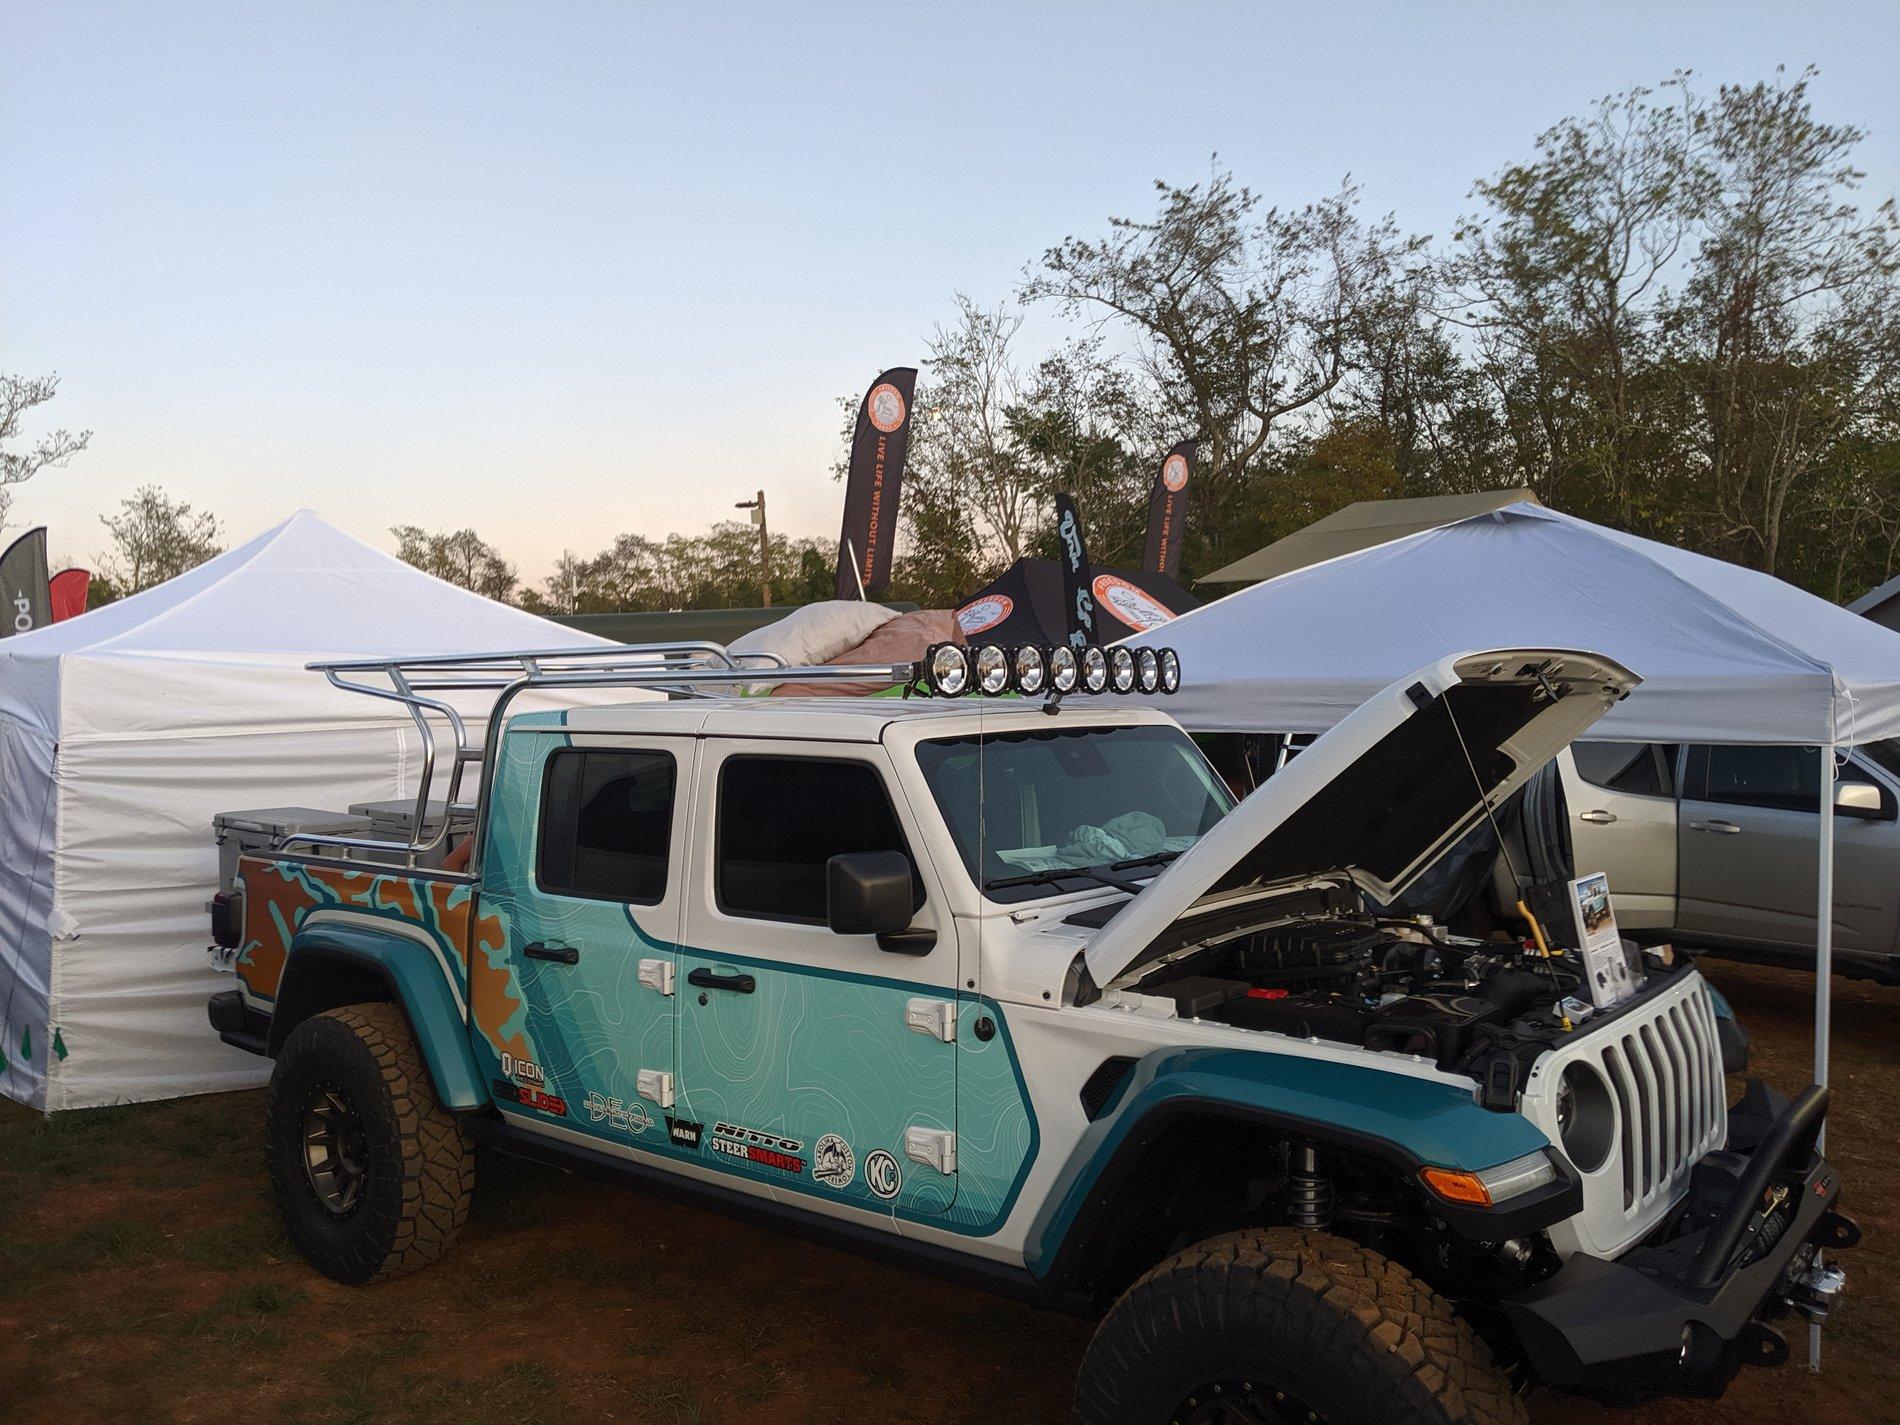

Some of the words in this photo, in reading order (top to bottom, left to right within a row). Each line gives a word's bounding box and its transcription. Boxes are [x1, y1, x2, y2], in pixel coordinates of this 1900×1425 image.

[876, 435, 887, 461] LIVE
[874, 464, 884, 487] LIFE
[868, 490, 881, 546] WITHOUT
[862, 548, 874, 588] LIMITS
[14, 598, 33, 635] PO
[514, 1058, 544, 1081] ICON
[493, 1079, 567, 1117] SLIDE
[673, 1127, 697, 1142] WARN
[713, 1121, 801, 1152] NITTO
[711, 1136, 802, 1173] STEERSMARTS
[869, 1155, 895, 1193] KC
